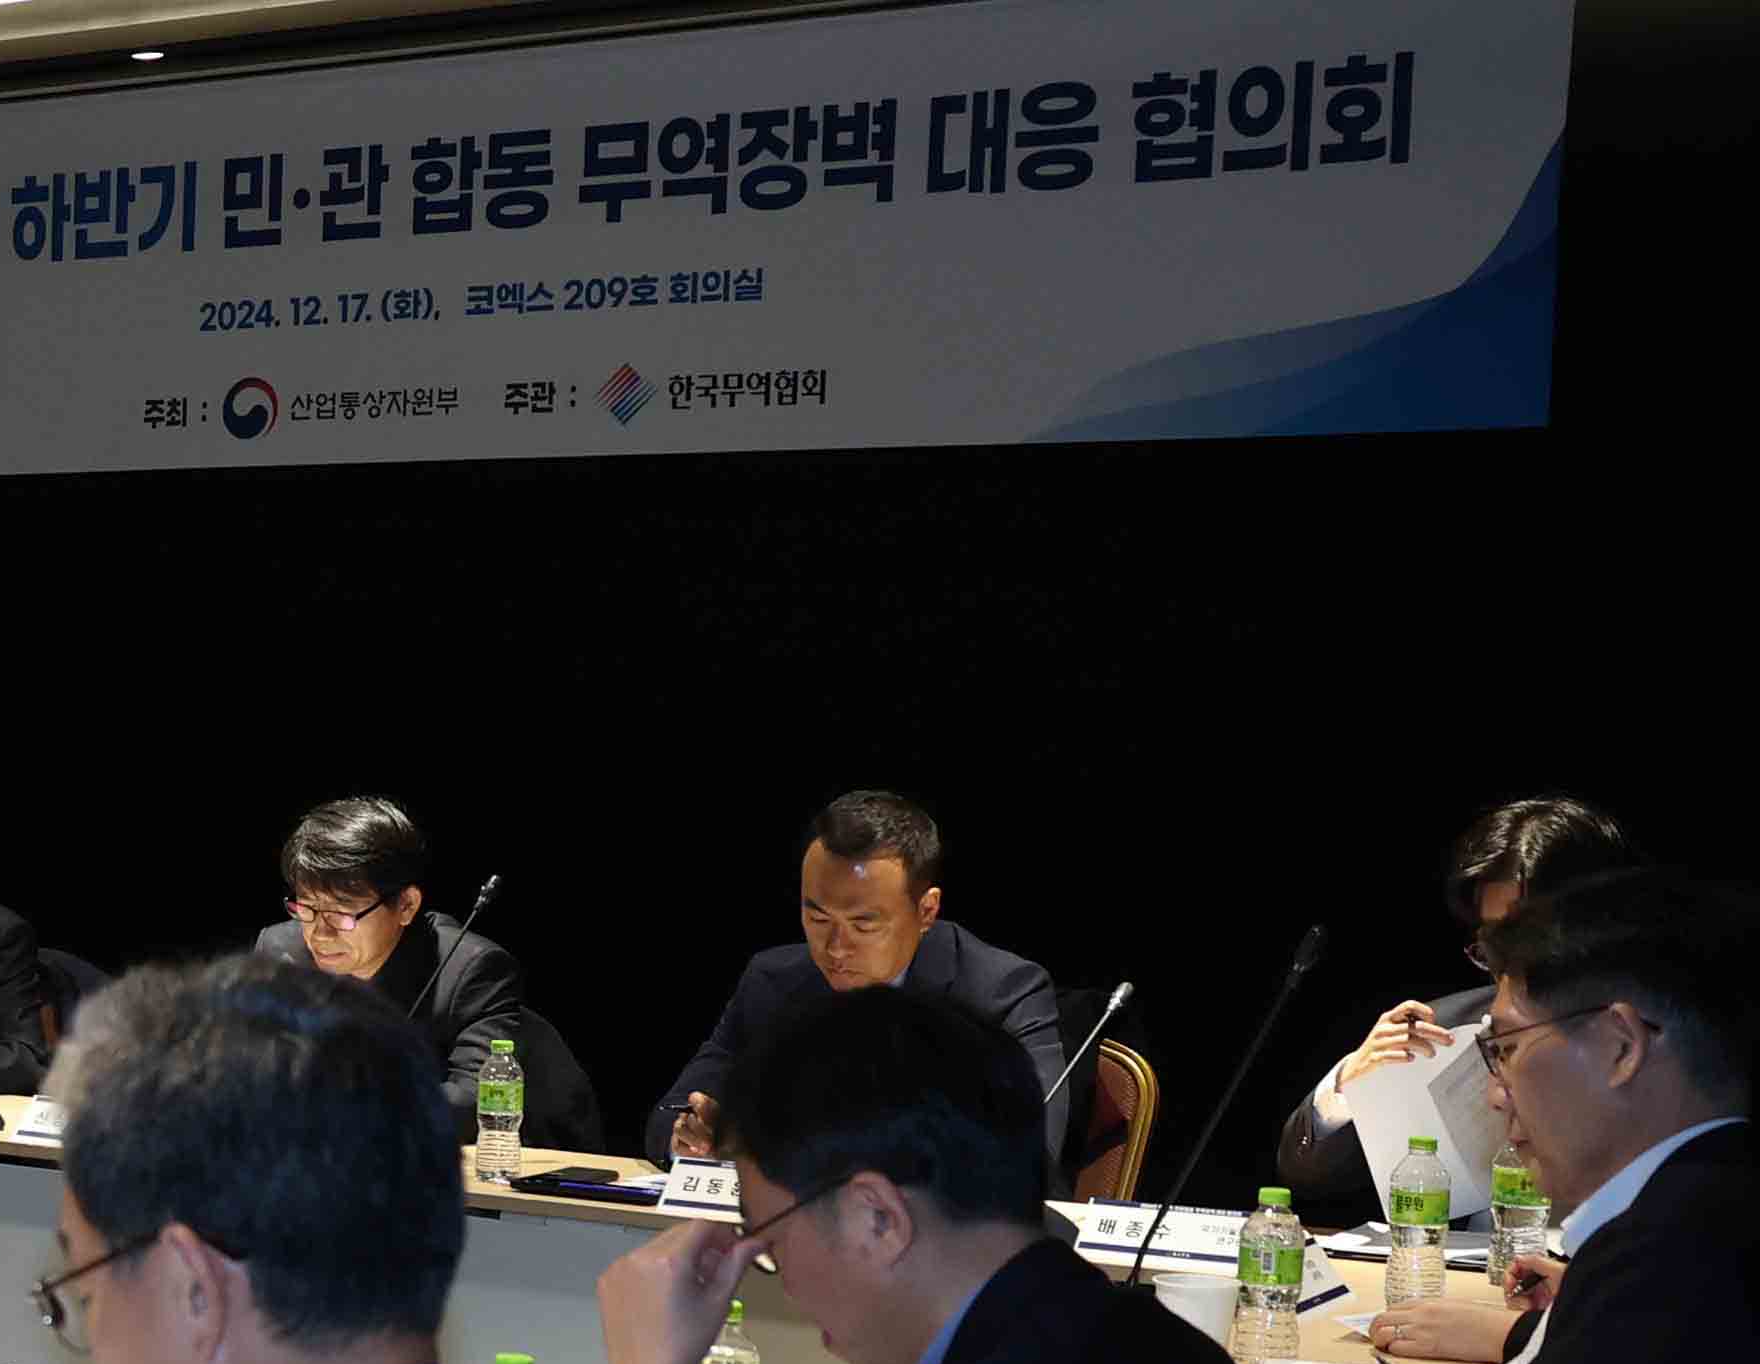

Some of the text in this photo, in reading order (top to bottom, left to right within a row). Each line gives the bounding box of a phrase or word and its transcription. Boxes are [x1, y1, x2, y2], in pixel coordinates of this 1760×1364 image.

[11, 161, 197, 262] 하반기
[411, 128, 554, 236] 합동
[578, 98, 898, 223] 무역장벽
[926, 81, 1100, 194] 대응
[1131, 51, 1416, 184] 협의회
[200, 268, 763, 331] 2024. 12. 17. (화), 코엑스 209호 회의실
[144, 397, 187, 429] 주최
[290, 387, 459, 421] 산업통상자원부
[504, 381, 556, 415] 주관
[669, 369, 826, 410] 한국무역협회
